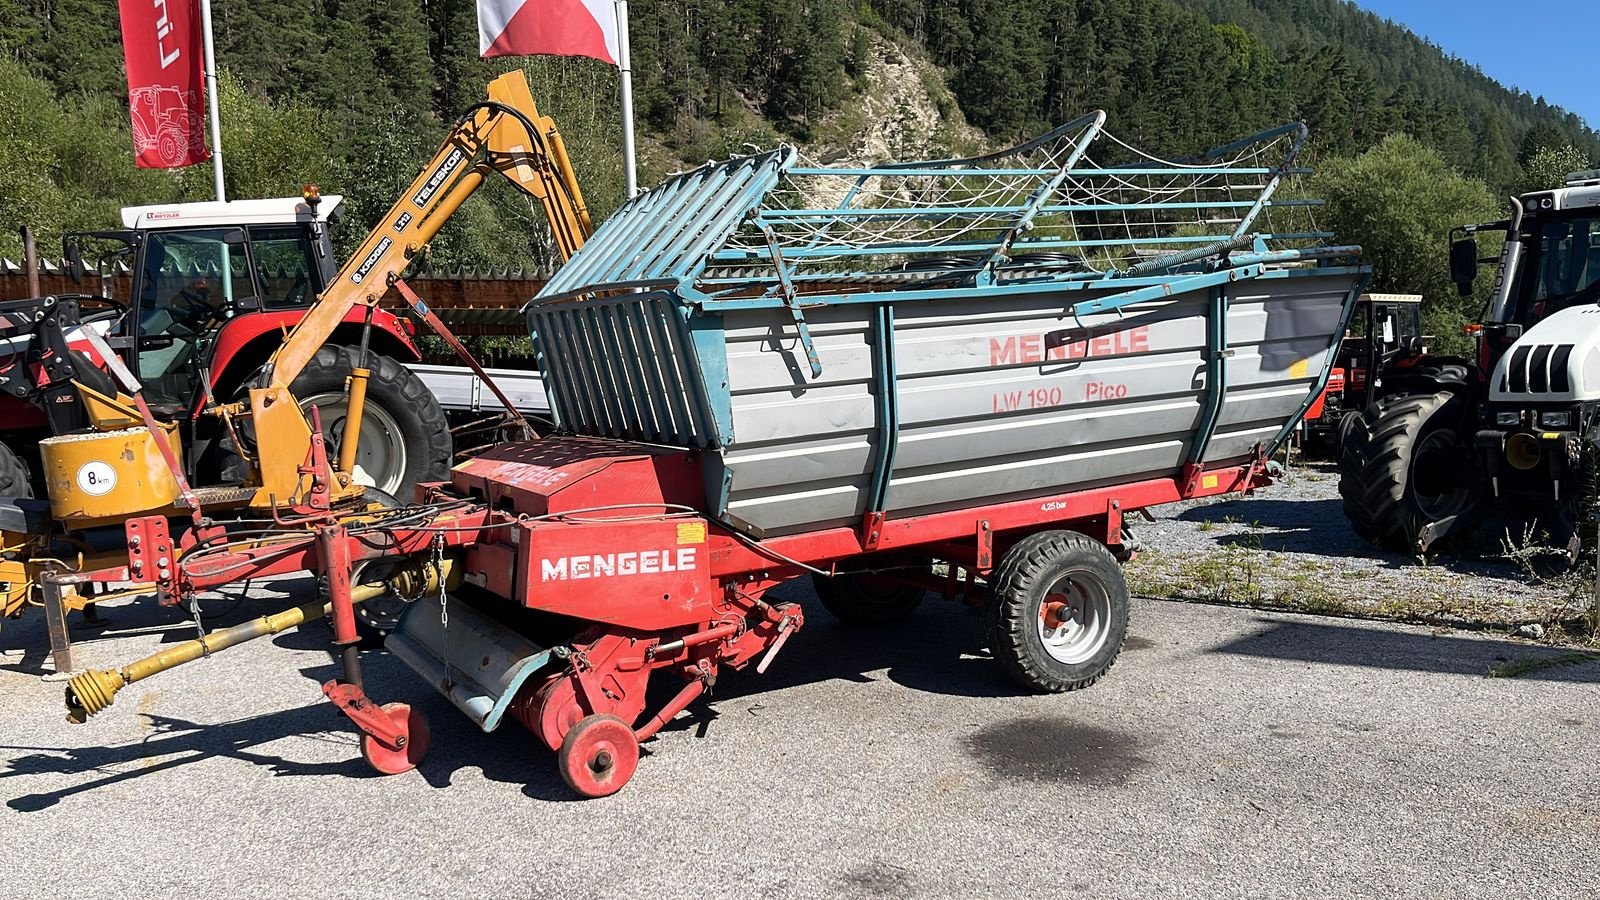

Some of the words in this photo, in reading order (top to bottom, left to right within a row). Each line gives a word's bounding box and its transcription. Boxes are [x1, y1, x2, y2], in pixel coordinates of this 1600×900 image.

[415, 149, 462, 205] TELESKOP
[394, 213, 410, 231] L212
[989, 326, 1149, 366] MENGELE
[993, 391, 1023, 413] LW
[1028, 387, 1062, 408] 190
[1086, 382, 1127, 400] Pico
[88, 471, 96, 485] 8
[1041, 501, 1056, 512] 4,25
[1056, 501, 1067, 509] bar
[541, 547, 697, 582] MENGELE
